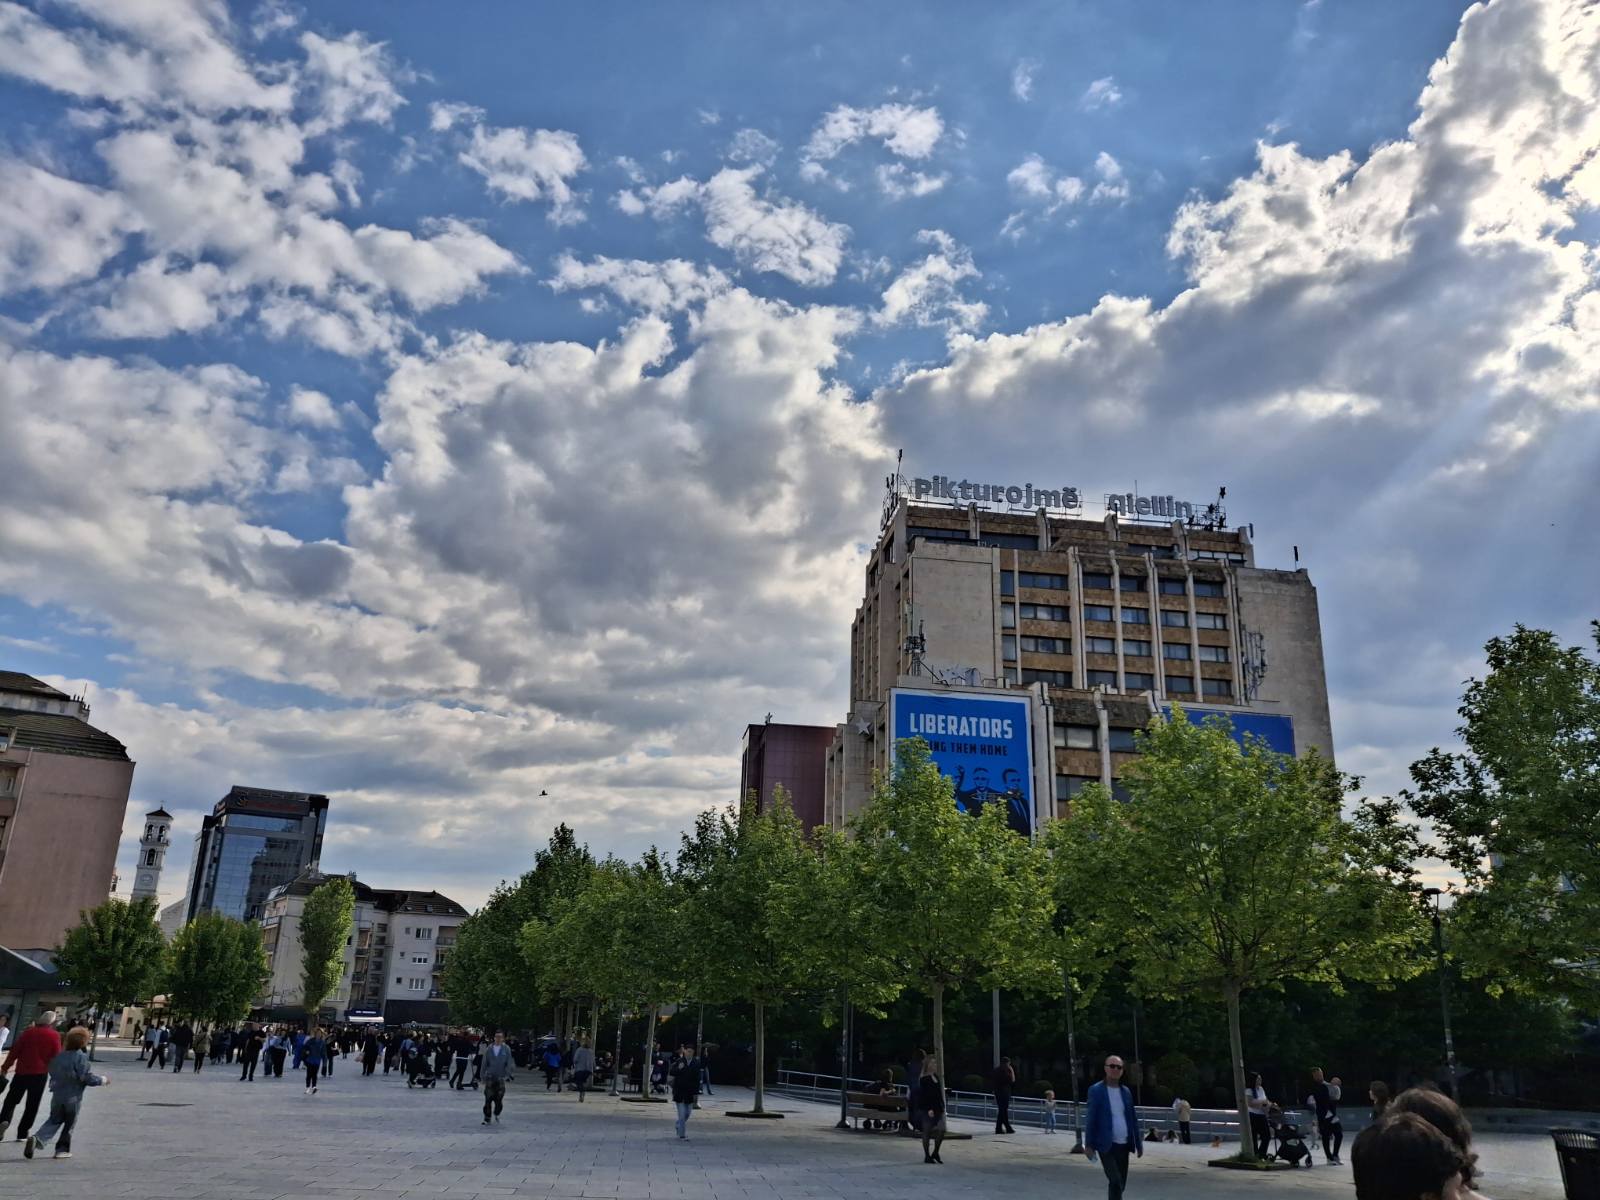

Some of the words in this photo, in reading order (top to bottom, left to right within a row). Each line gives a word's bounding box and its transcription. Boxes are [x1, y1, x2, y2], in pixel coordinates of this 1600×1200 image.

[914, 475, 1079, 509] pikturojmë
[1109, 493, 1192, 518] qiellin
[910, 712, 1013, 739] LIBERATORS
[951, 742, 977, 754] THEM
[980, 744, 1008, 756] HOME
